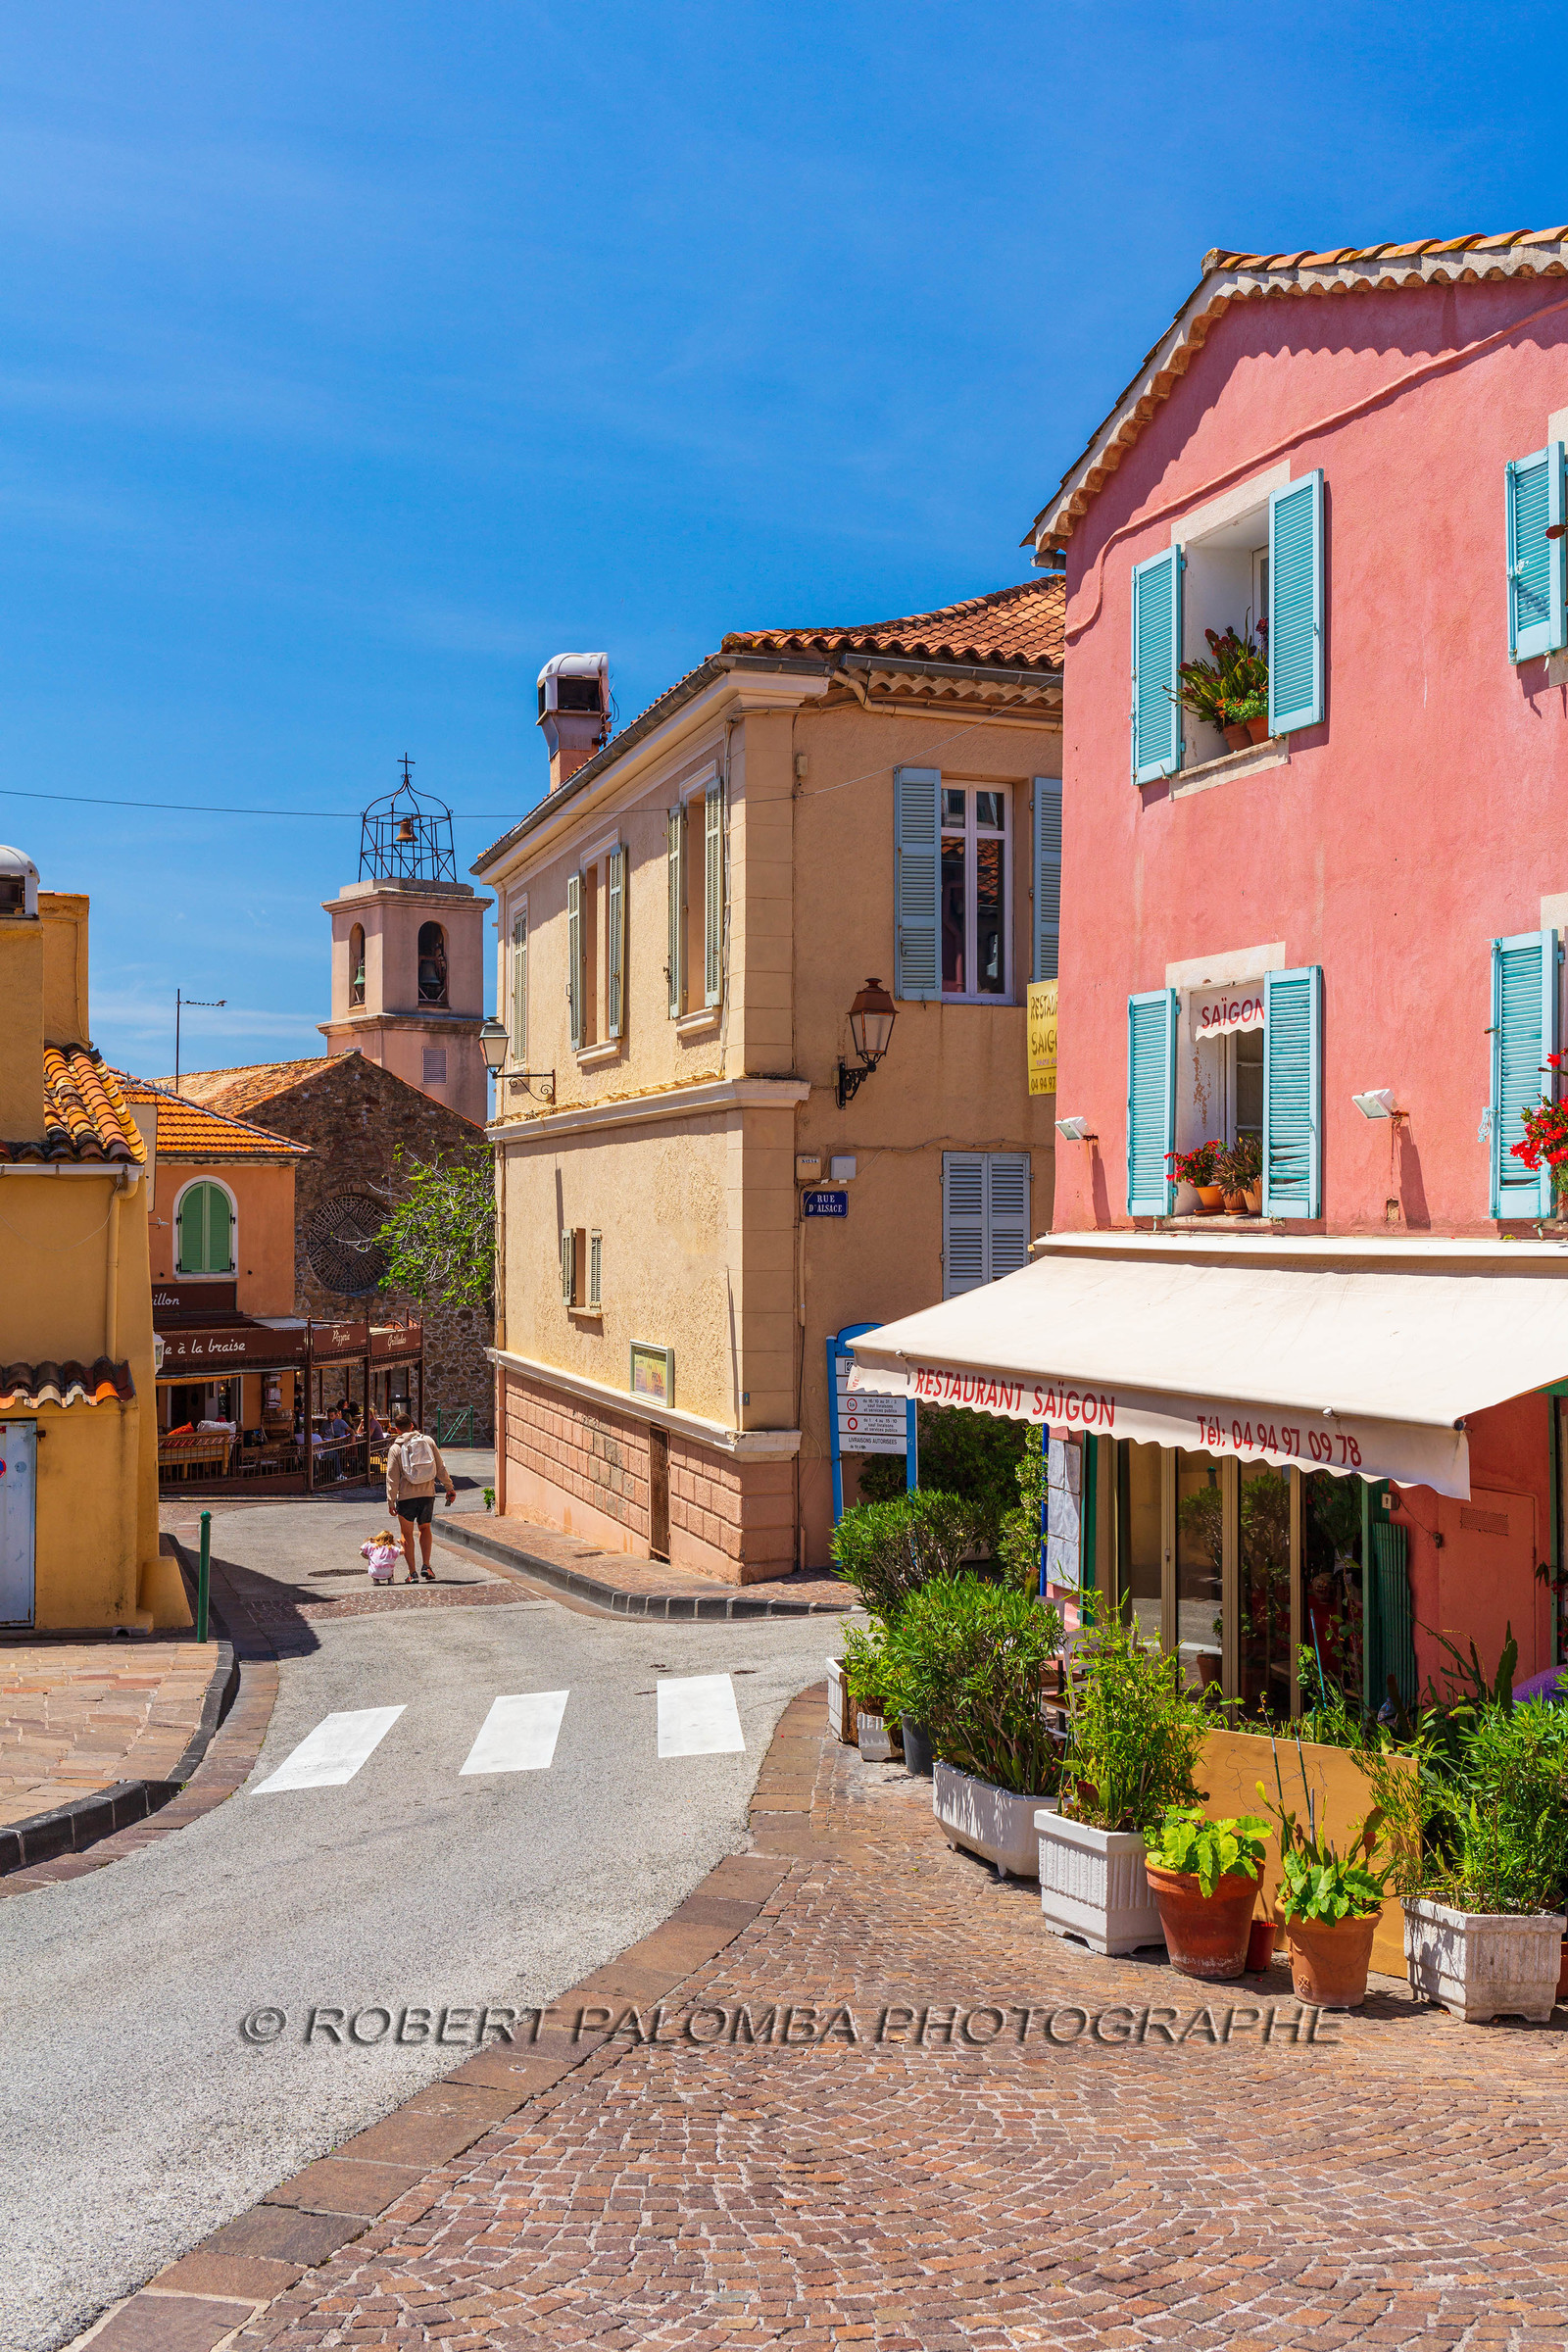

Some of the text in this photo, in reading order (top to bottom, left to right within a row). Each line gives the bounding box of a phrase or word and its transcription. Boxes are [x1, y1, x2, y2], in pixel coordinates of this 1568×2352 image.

[1200, 997, 1264, 1029] SAÏGON
[1031, 1076, 1055, 1091] 04 94 97
[817, 1194, 835, 1203] RUE
[808, 1204, 843, 1213] D'ALSACE
[152, 1293, 179, 1305] illon
[177, 1343, 185, 1354] à
[191, 1339, 203, 1353] la
[208, 1338, 245, 1352] braise
[914, 1367, 1024, 1411] RESTAURANT
[1032, 1381, 1115, 1428] SAÏGON
[1232, 1420, 1253, 1450] 04
[1256, 1423, 1279, 1454] 94
[1281, 1427, 1300, 1457] 97
[1308, 1430, 1333, 1462] 09
[1336, 1434, 1362, 1467] 78
